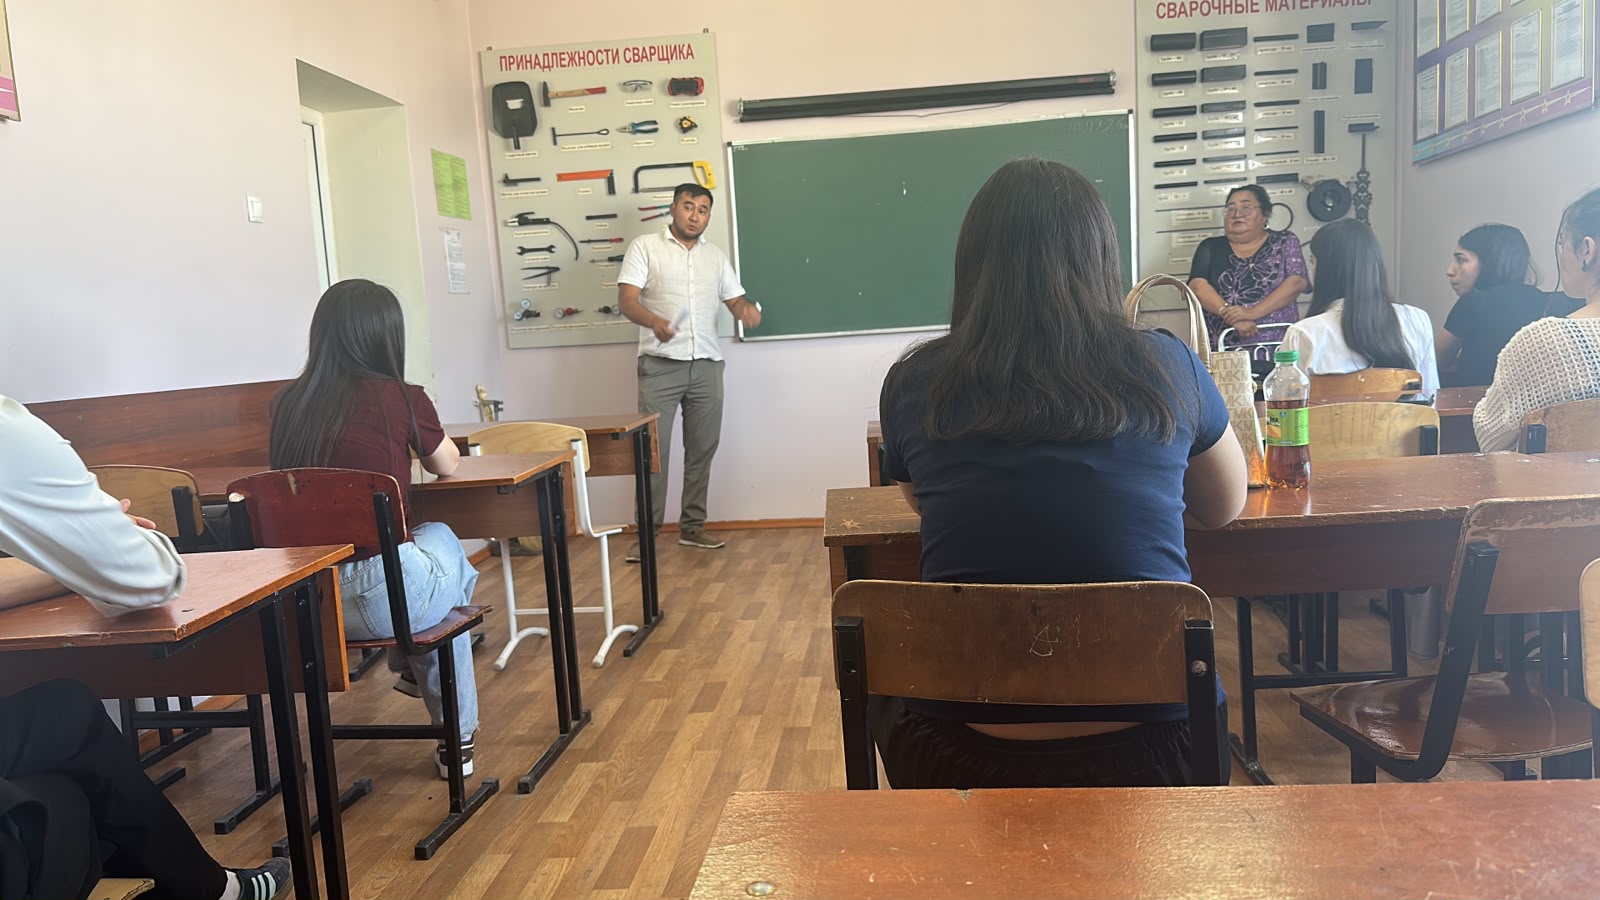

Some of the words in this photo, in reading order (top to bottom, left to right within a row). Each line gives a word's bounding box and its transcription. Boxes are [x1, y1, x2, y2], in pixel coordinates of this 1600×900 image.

[1156, 0, 1259, 19] СВАРОЧНЫЕ
[500, 48, 620, 72] ПРИНАДЛЕЖНОСТИ
[623, 43, 695, 64] СВАРЩИКА
